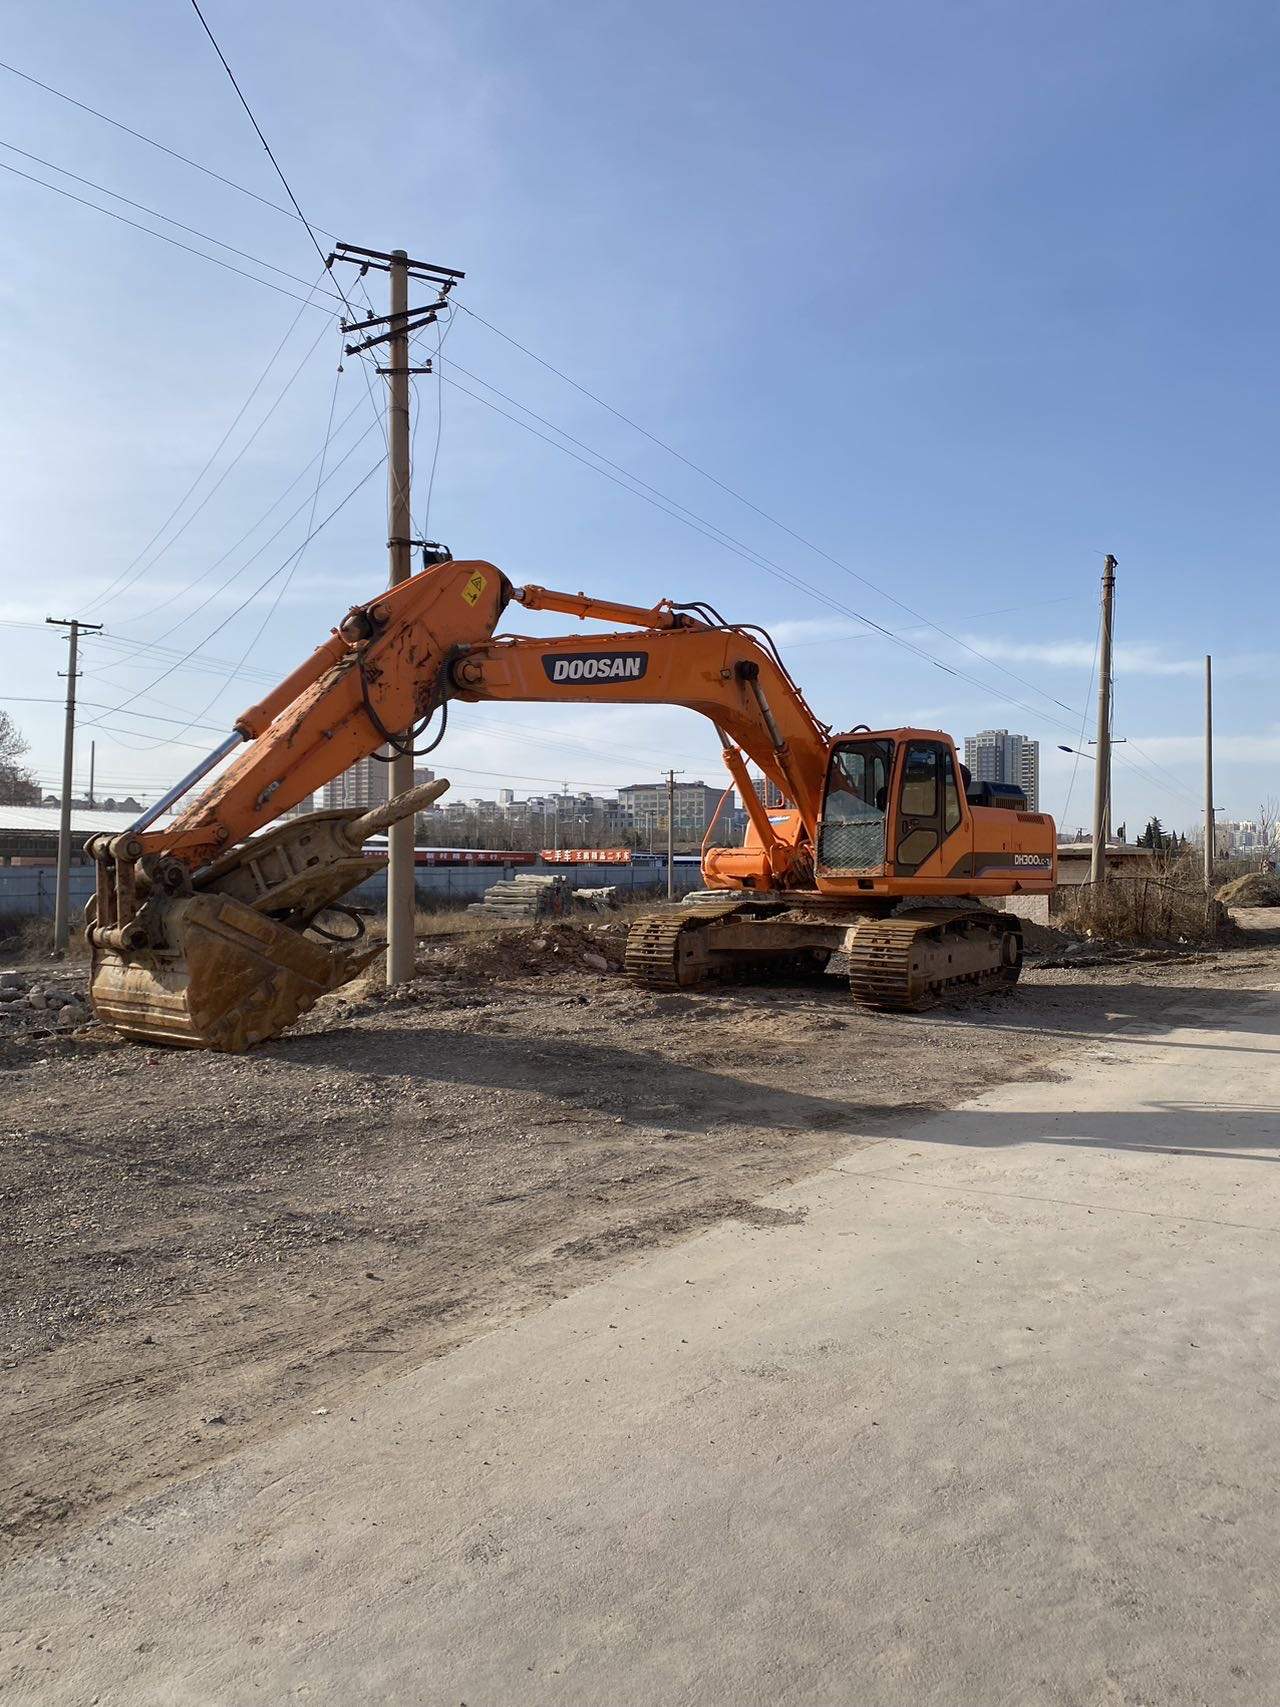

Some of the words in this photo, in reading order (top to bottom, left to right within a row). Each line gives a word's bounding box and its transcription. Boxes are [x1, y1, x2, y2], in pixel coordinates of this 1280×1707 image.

[553, 657, 641, 680] DOOSAN
[544, 849, 572, 862] 二手车
